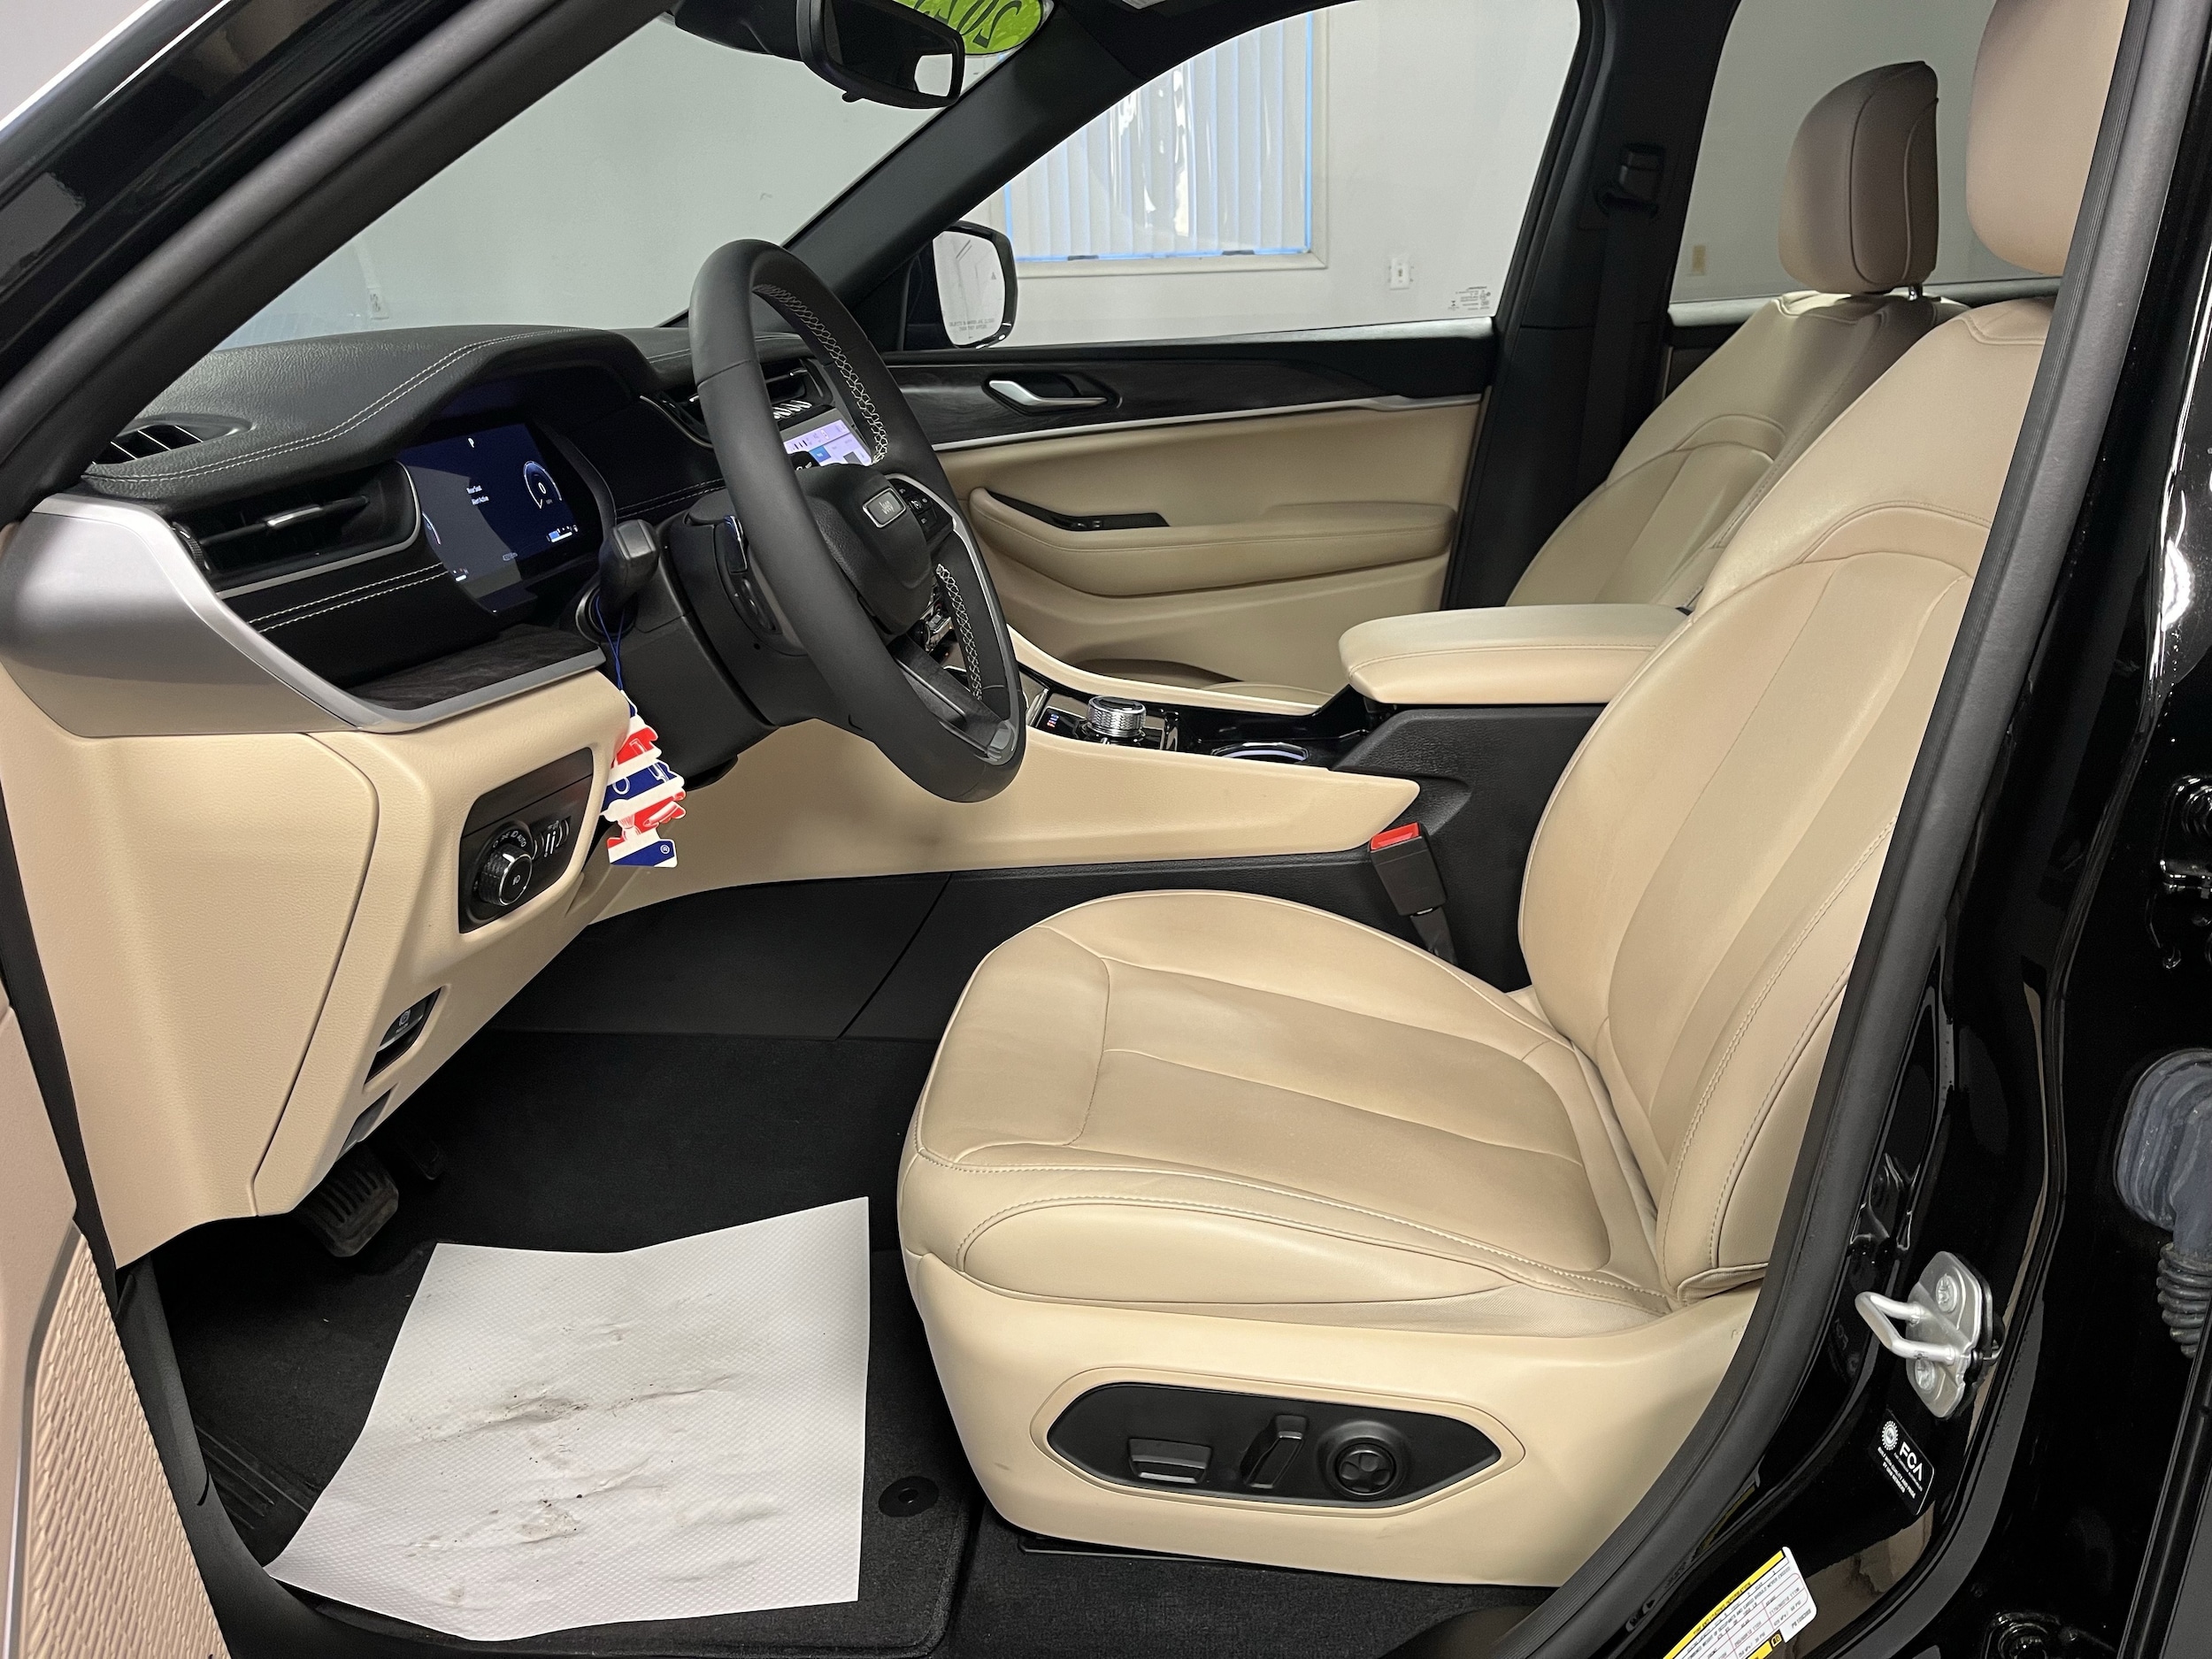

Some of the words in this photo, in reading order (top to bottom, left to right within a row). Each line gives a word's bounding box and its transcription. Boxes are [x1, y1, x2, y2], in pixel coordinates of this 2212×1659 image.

[468, 437, 474, 448] P
[538, 482, 546, 494] 0
[517, 834, 526, 848] AUTO
[1899, 1441, 1923, 1481] FCA
